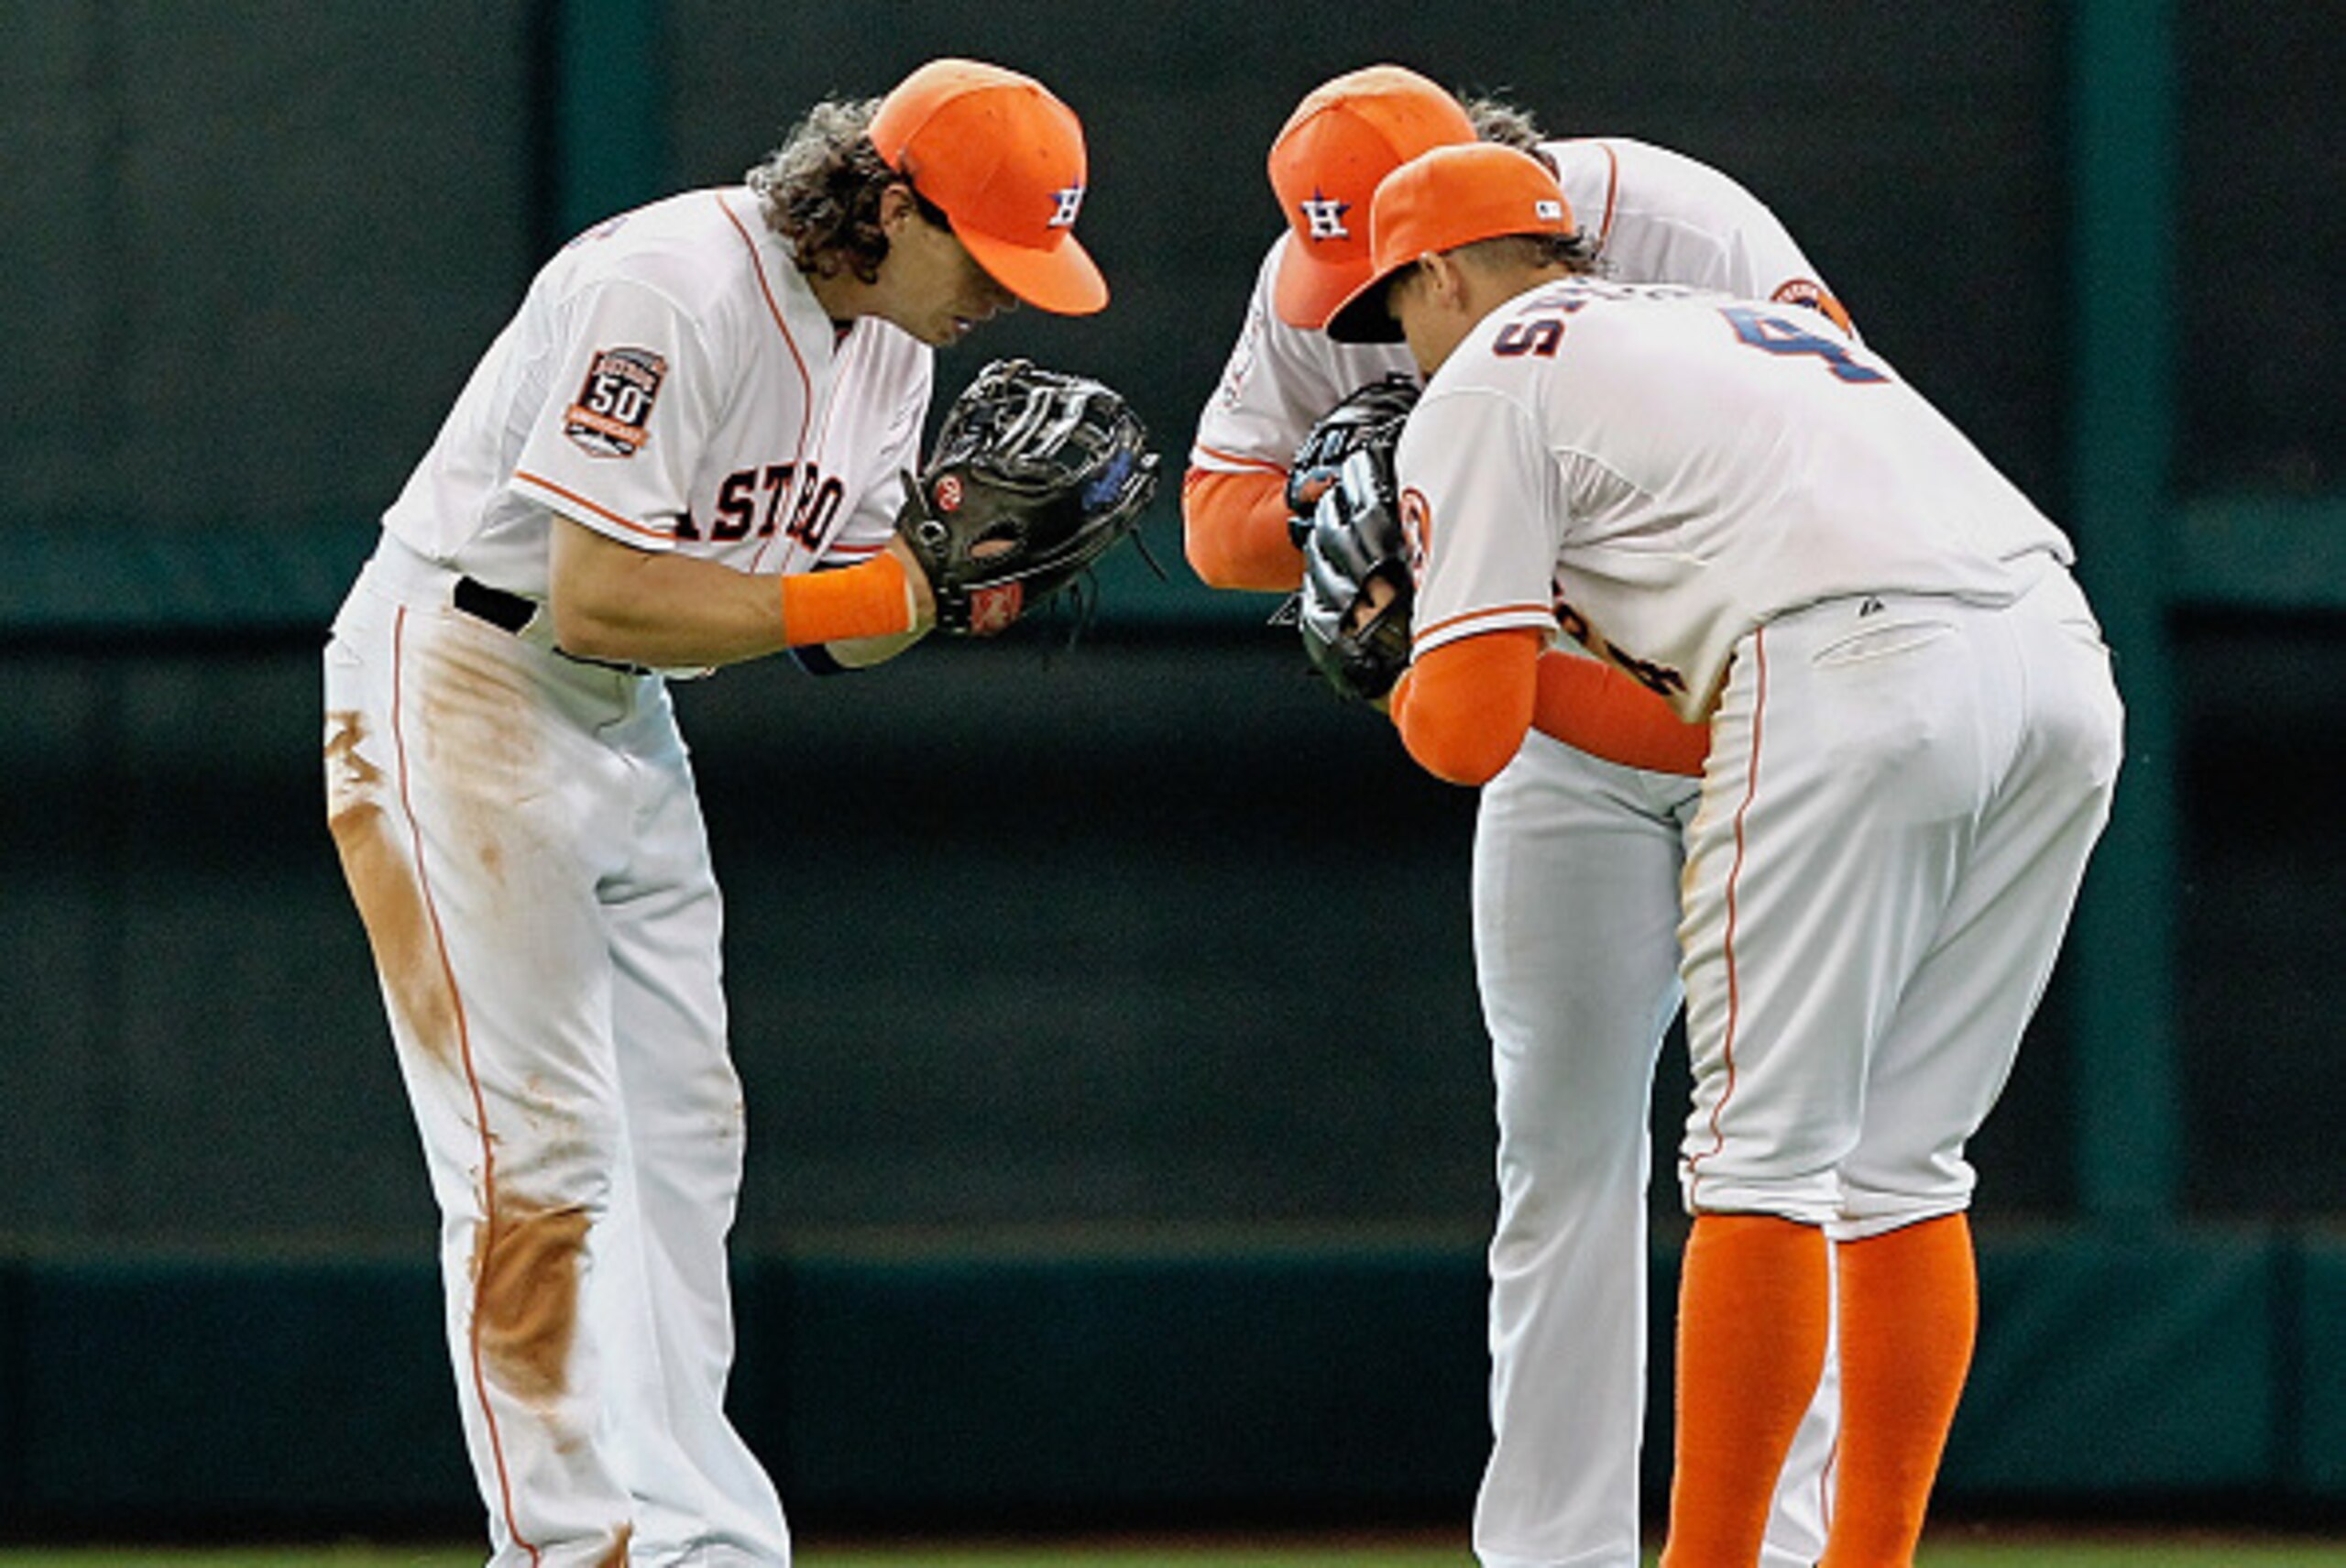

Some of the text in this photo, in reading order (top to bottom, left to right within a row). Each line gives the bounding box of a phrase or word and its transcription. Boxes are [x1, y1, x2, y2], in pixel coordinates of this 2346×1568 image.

[1047, 188, 1083, 228] H
[1301, 200, 1350, 240] H
[1718, 307, 1892, 384] 4
[589, 373, 642, 423] 50
